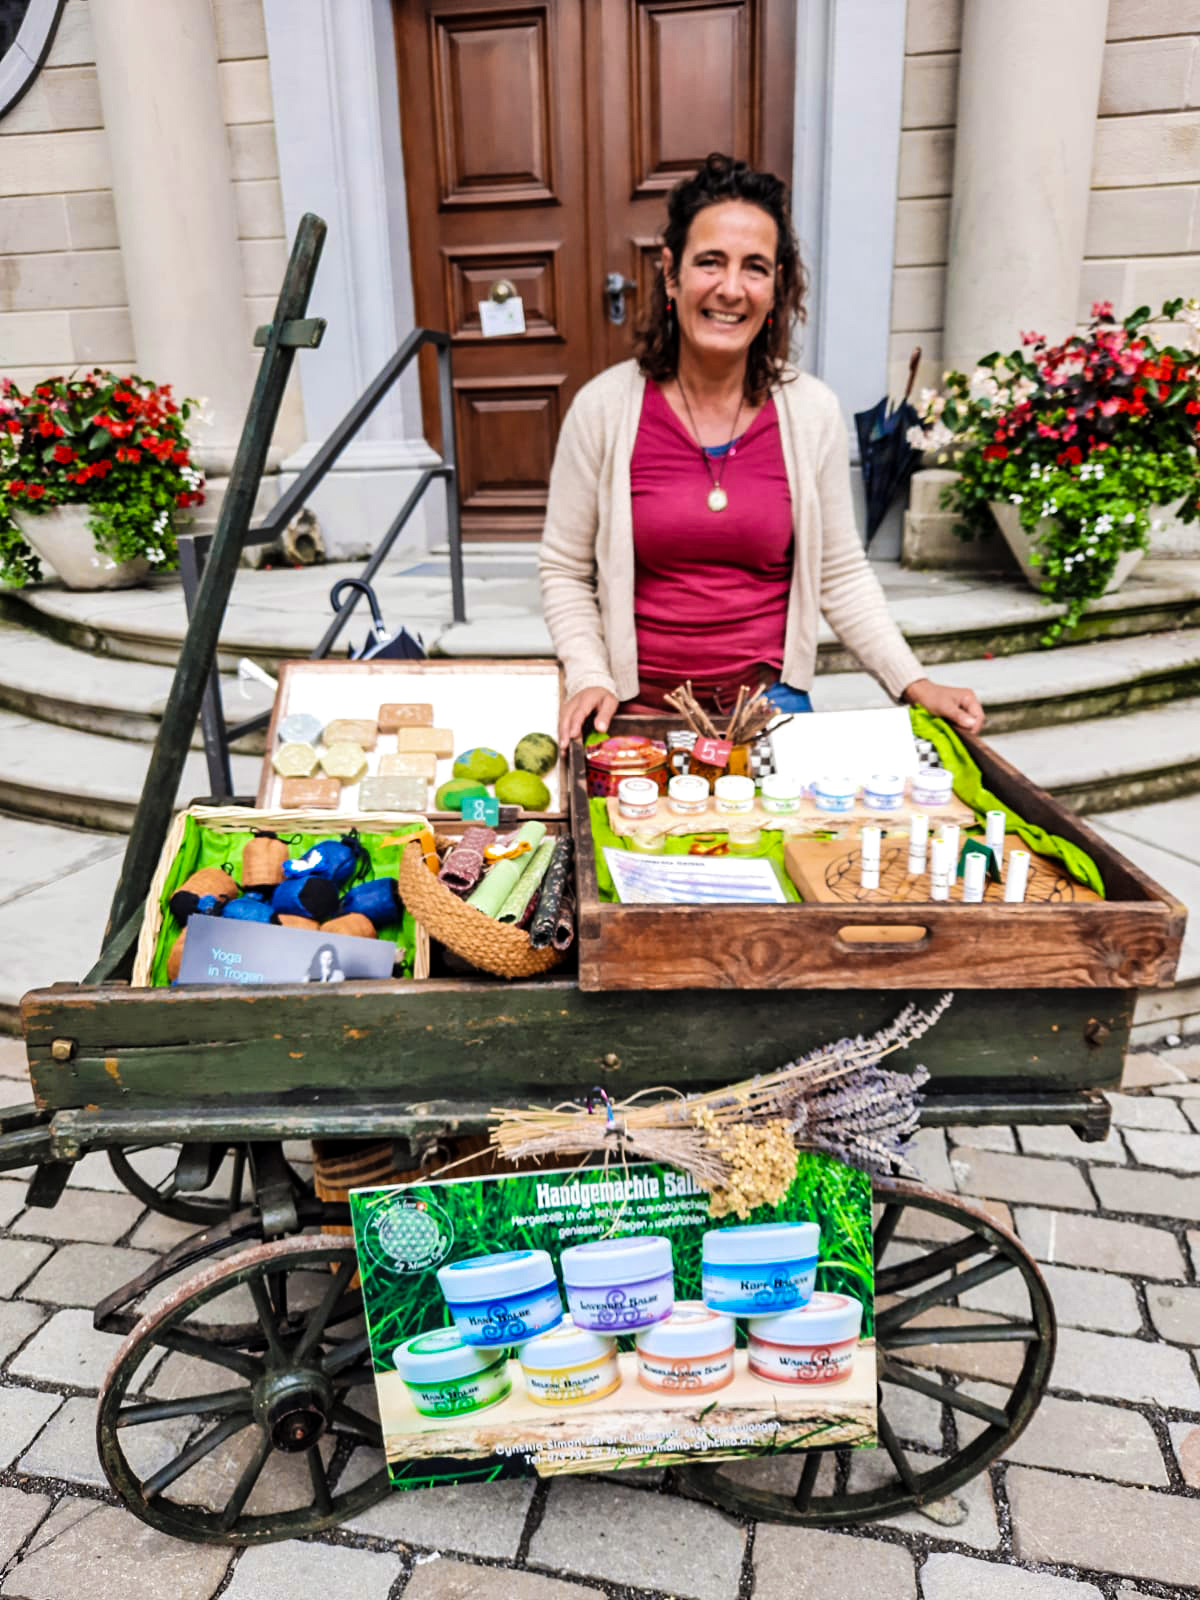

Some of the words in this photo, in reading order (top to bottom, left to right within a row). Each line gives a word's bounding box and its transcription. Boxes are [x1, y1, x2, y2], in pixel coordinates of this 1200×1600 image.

[211, 947, 242, 965] Yoga
[208, 966, 220, 977] in
[536, 1173, 660, 1208] Handgemachte
[511, 1212, 564, 1227] Hergestellt
[566, 1210, 575, 1220] in
[576, 1207, 593, 1220] der
